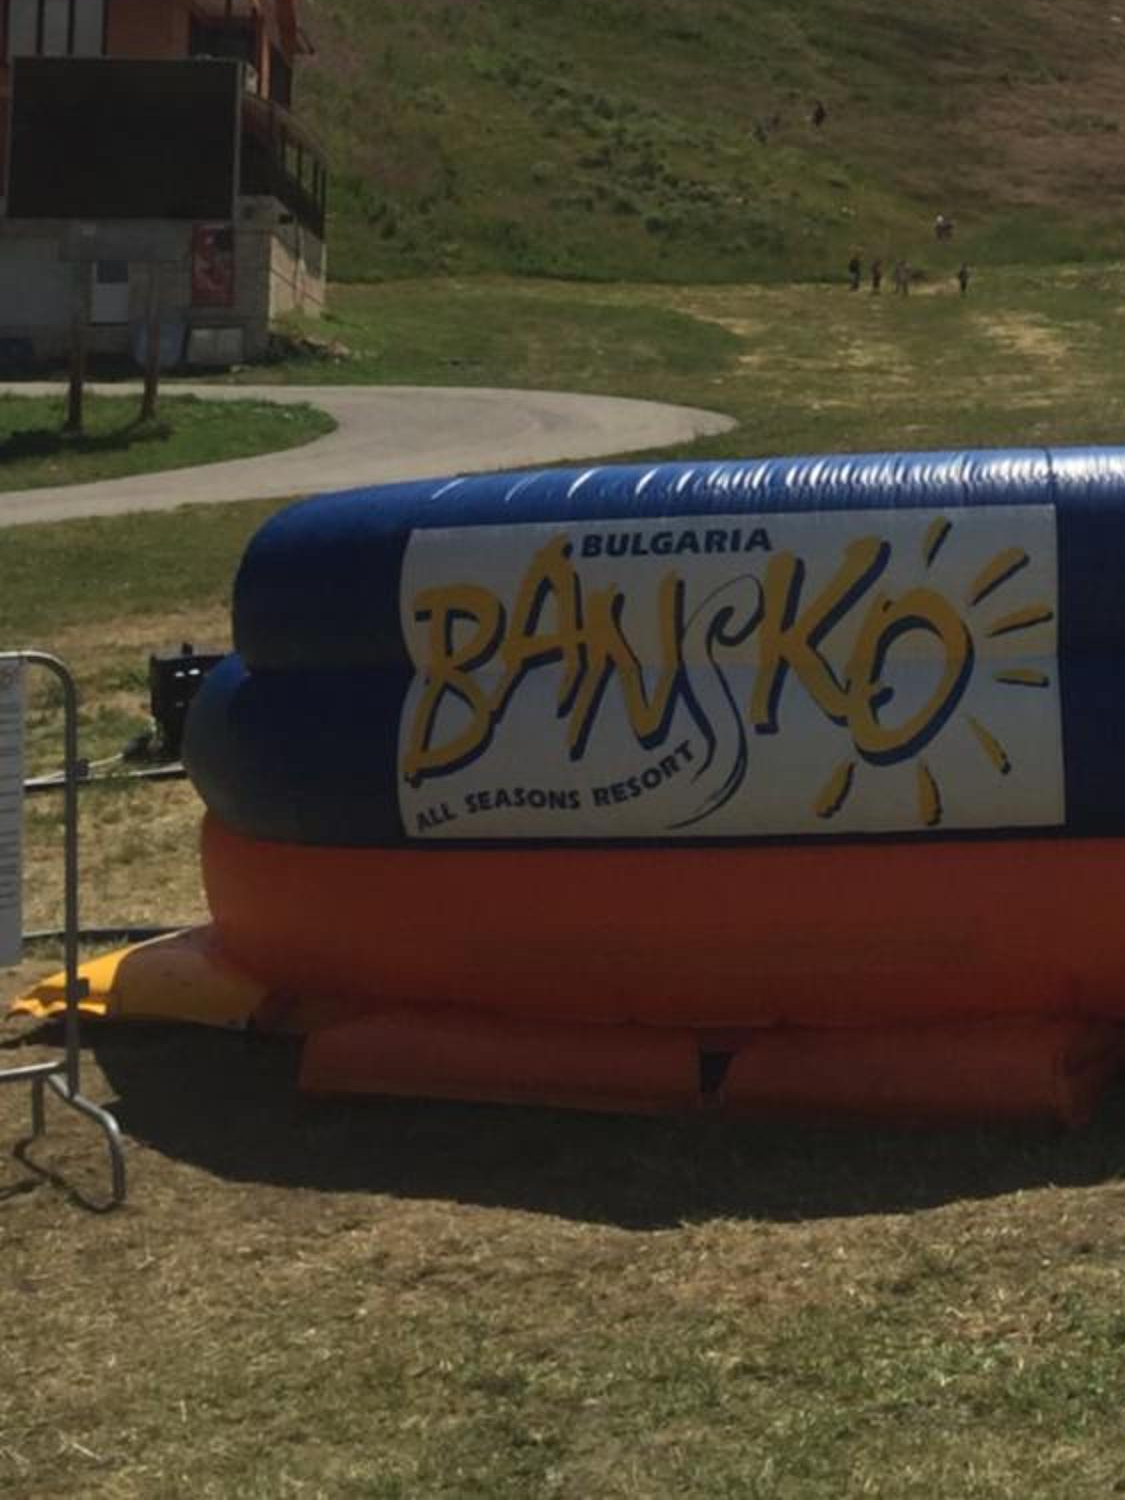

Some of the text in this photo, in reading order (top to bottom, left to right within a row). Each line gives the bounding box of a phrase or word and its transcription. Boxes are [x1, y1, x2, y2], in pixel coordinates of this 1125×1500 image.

[580, 527, 773, 557] BULGARIA
[404, 532, 975, 830] BANSKO
[416, 740, 696, 831] ALL SEASONS RESORT
